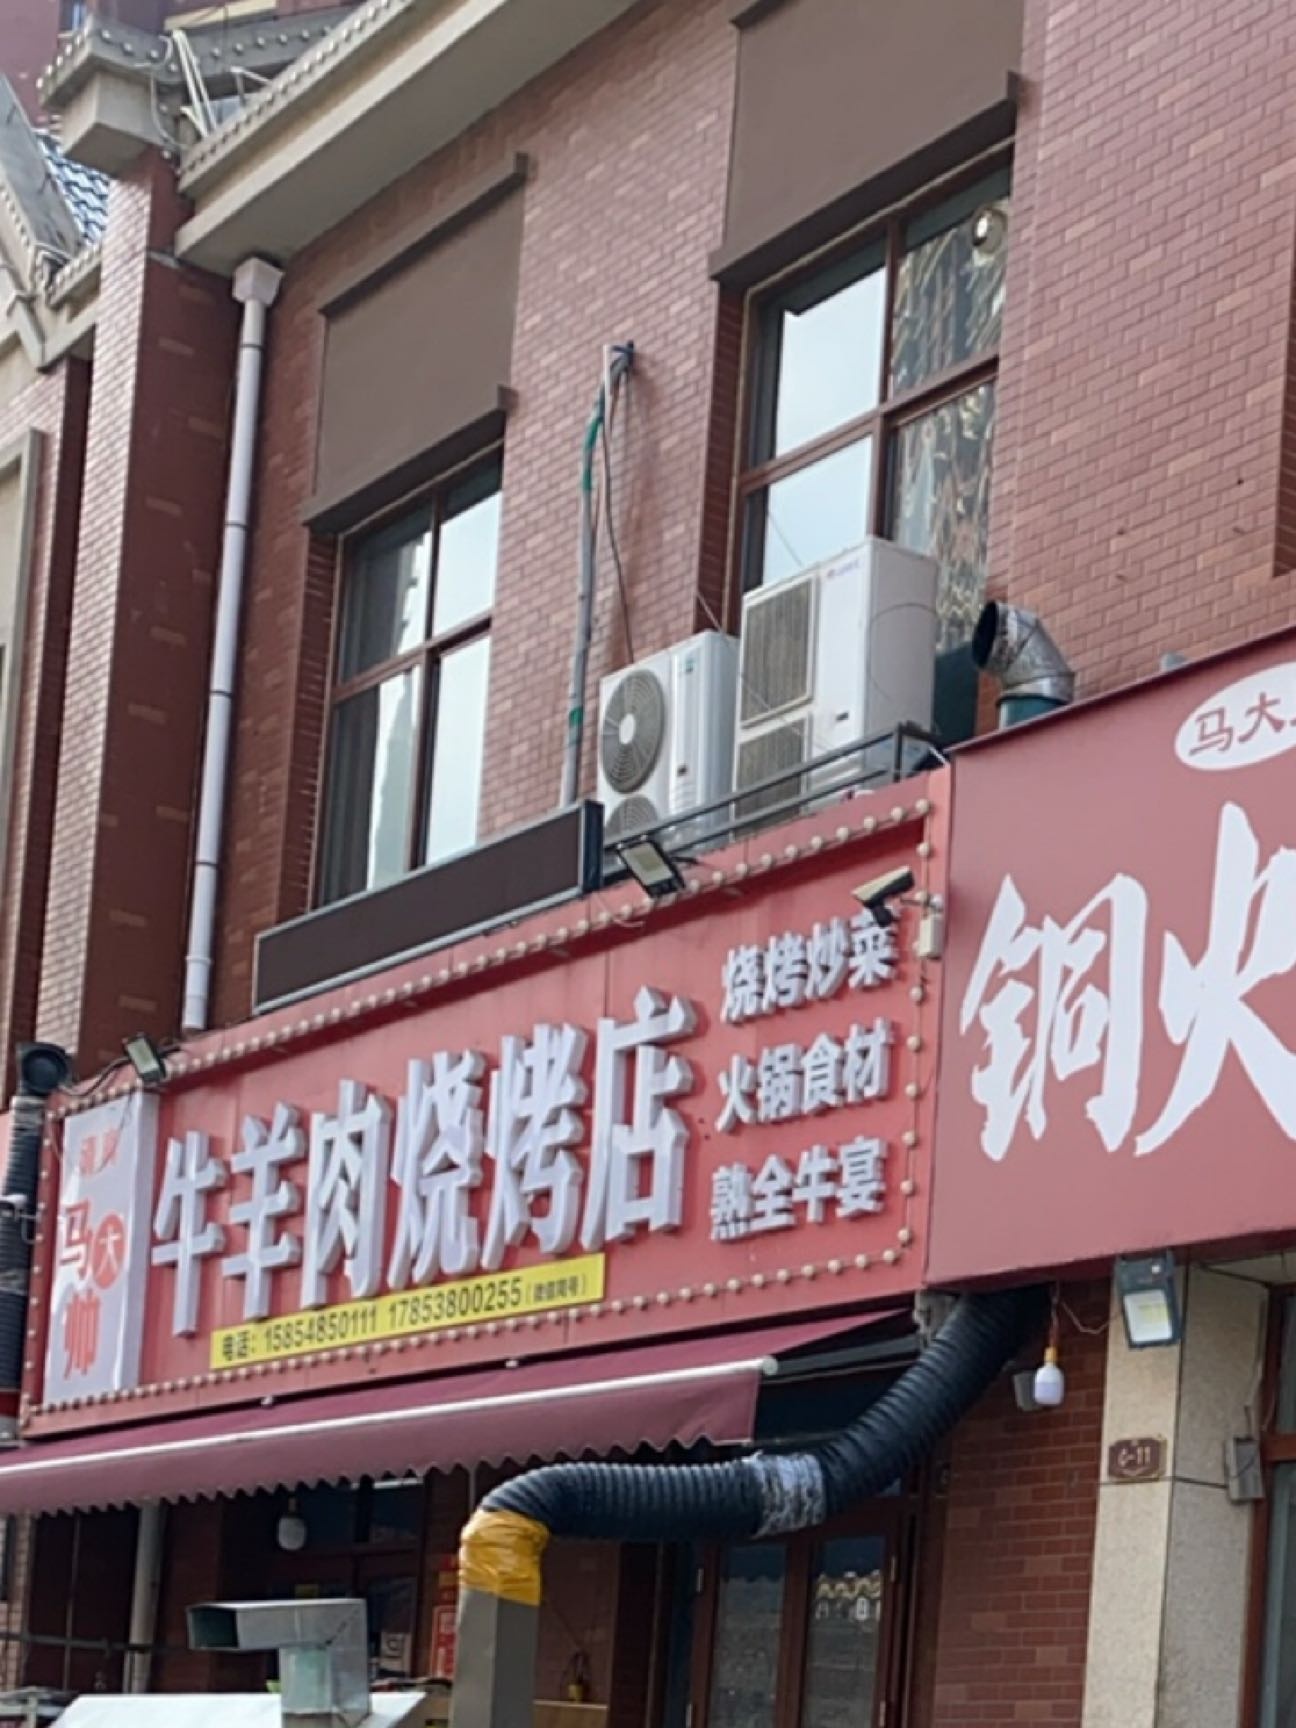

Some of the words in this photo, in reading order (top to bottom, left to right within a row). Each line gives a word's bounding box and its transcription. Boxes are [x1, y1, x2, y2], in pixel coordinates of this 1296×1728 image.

[720, 902, 899, 1024] 烧烤炒菜
[715, 1017, 893, 1133] 火锅食材
[152, 988, 696, 1337] 牛羊肉烧烤店
[711, 1136, 888, 1241] 熟全牛宴
